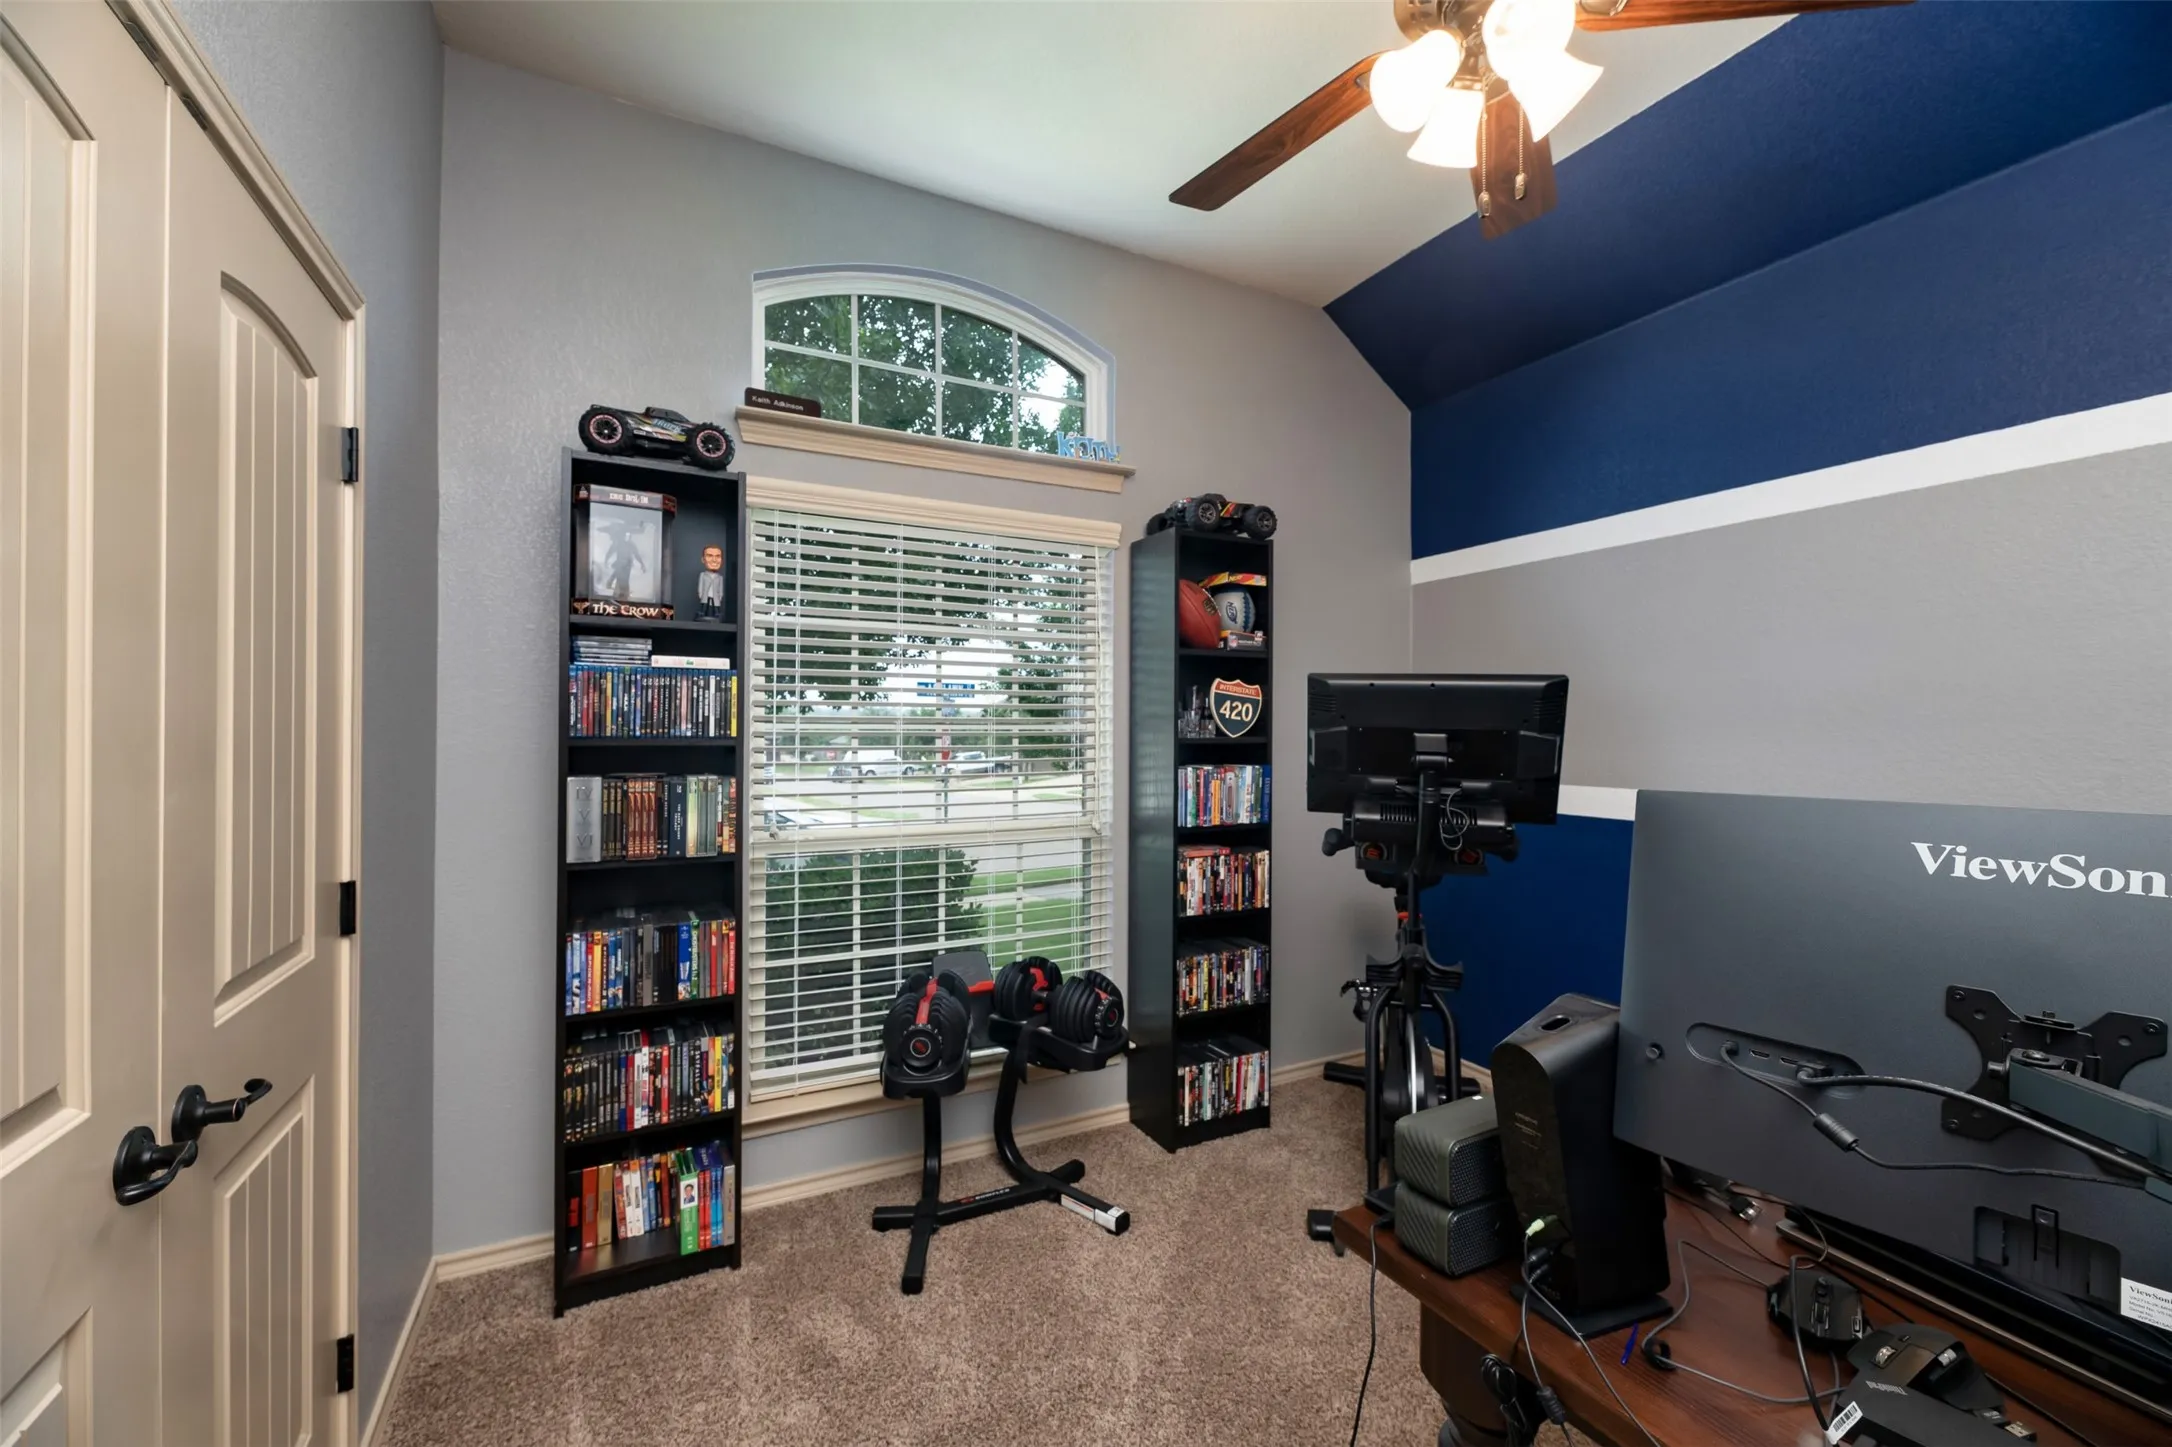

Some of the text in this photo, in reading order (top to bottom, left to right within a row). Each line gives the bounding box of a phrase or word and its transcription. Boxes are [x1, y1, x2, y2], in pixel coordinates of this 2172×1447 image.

[1219, 683, 1257, 696] INTERSTATE
[1219, 699, 1254, 722] 420
[1910, 841, 2172, 898] ViewSon
